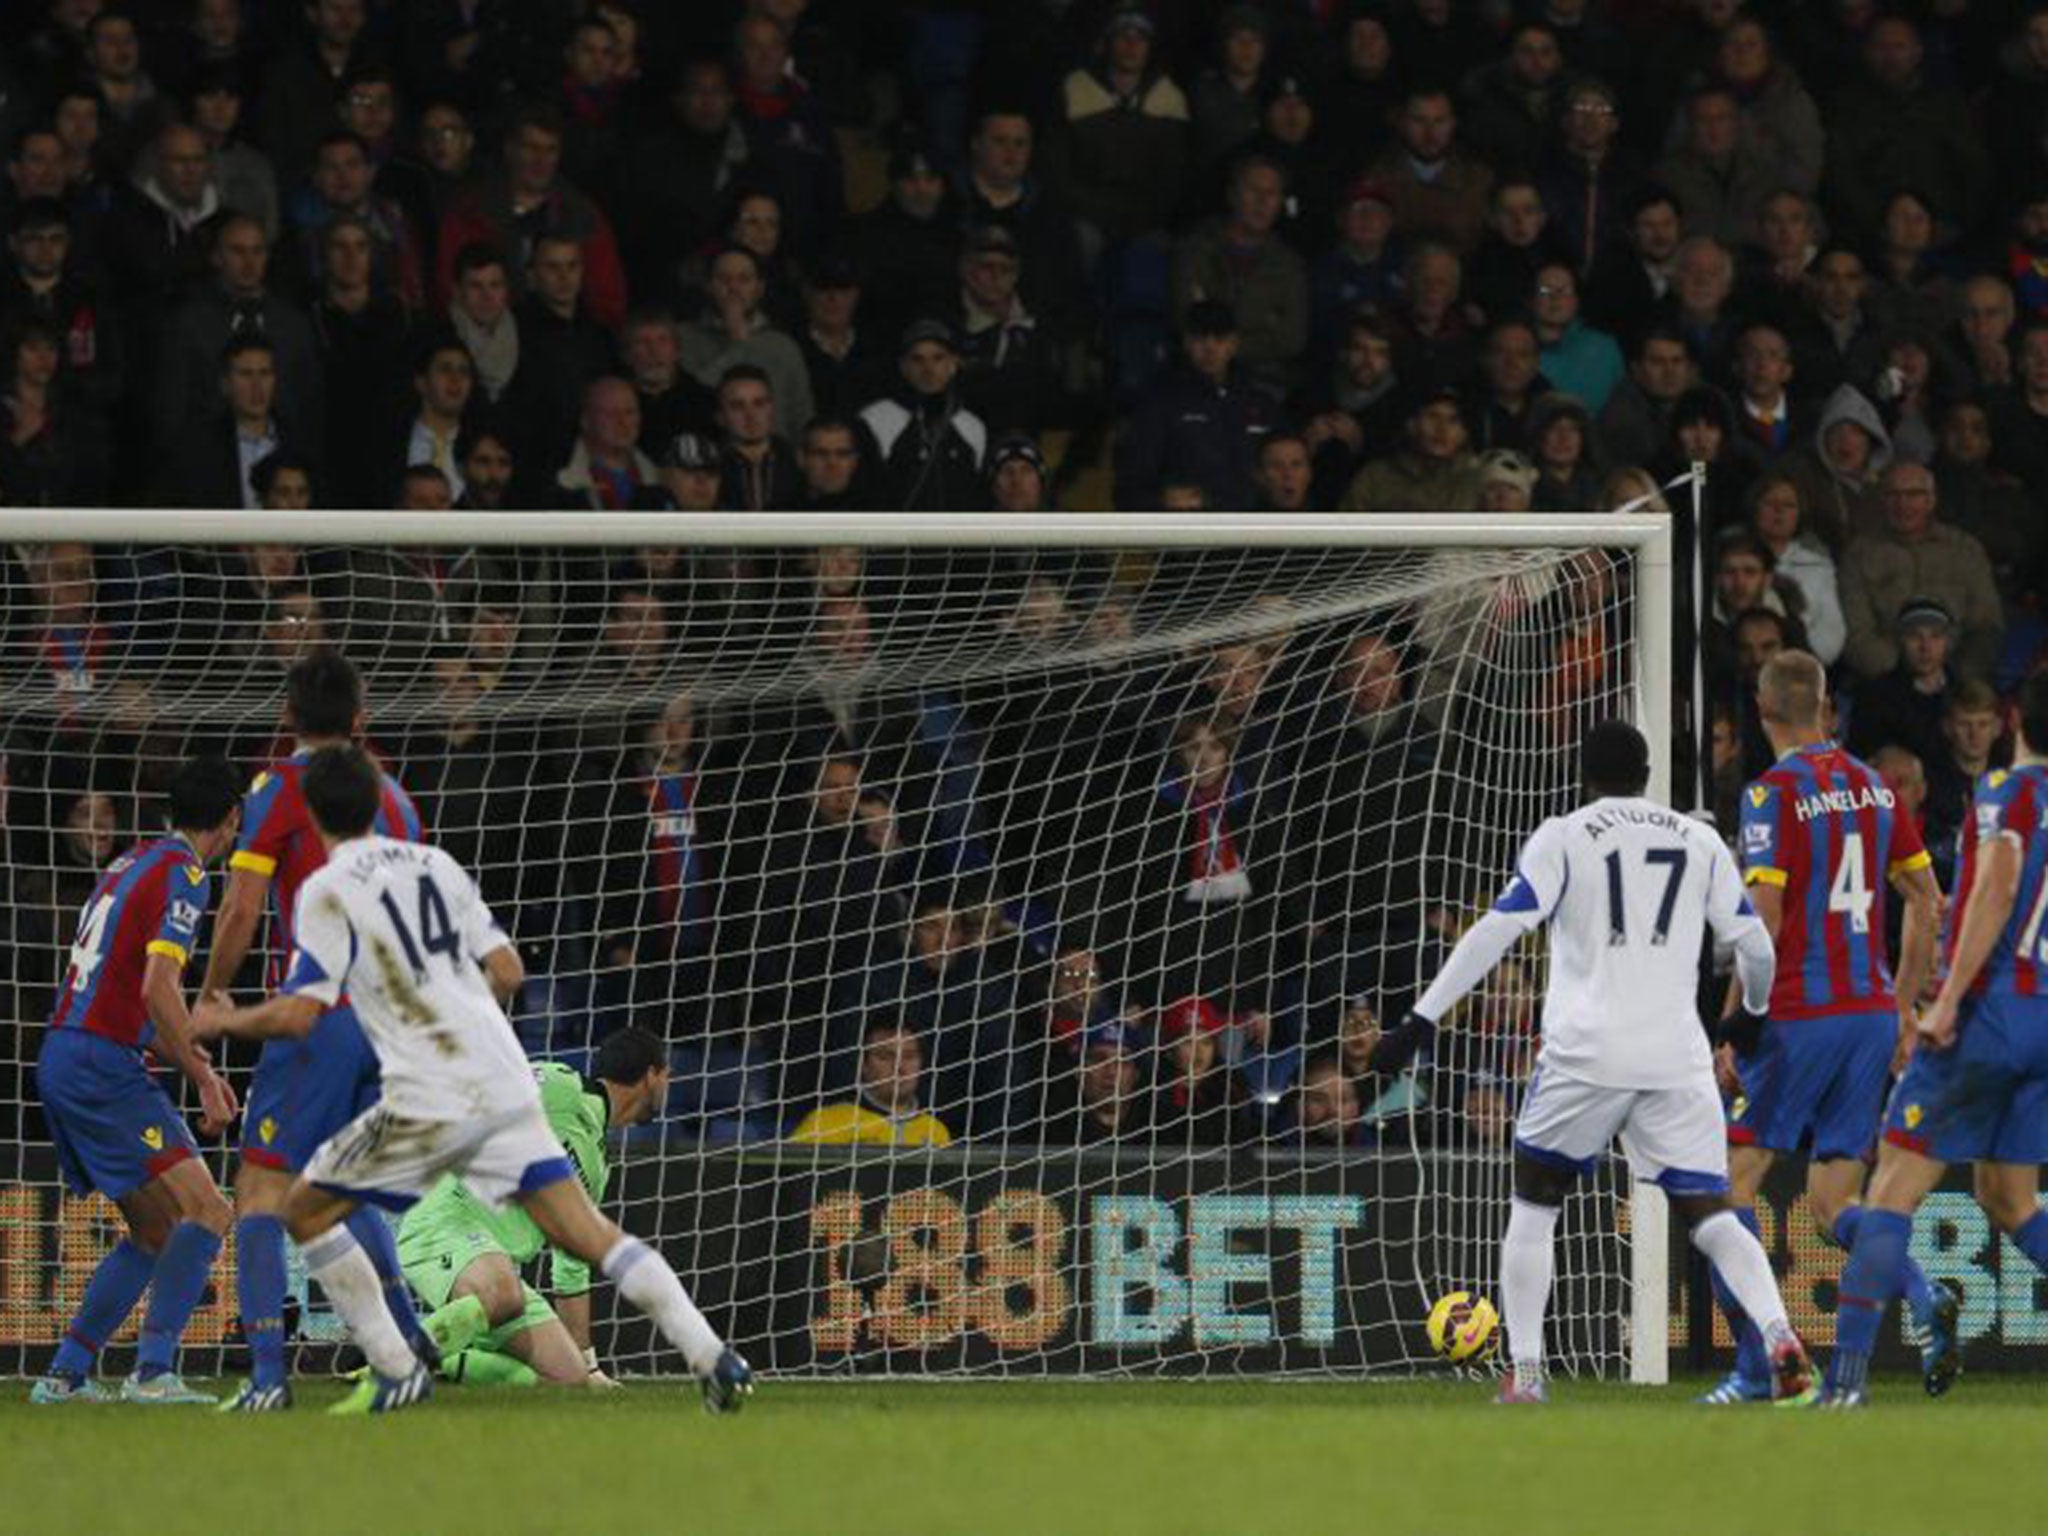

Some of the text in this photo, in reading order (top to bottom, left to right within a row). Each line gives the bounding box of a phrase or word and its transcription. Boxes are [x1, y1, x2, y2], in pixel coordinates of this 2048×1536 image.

[380, 873, 462, 984] 14
[1604, 848, 1688, 946] 17
[1828, 832, 1876, 934] 4
[65, 893, 117, 993] 4
